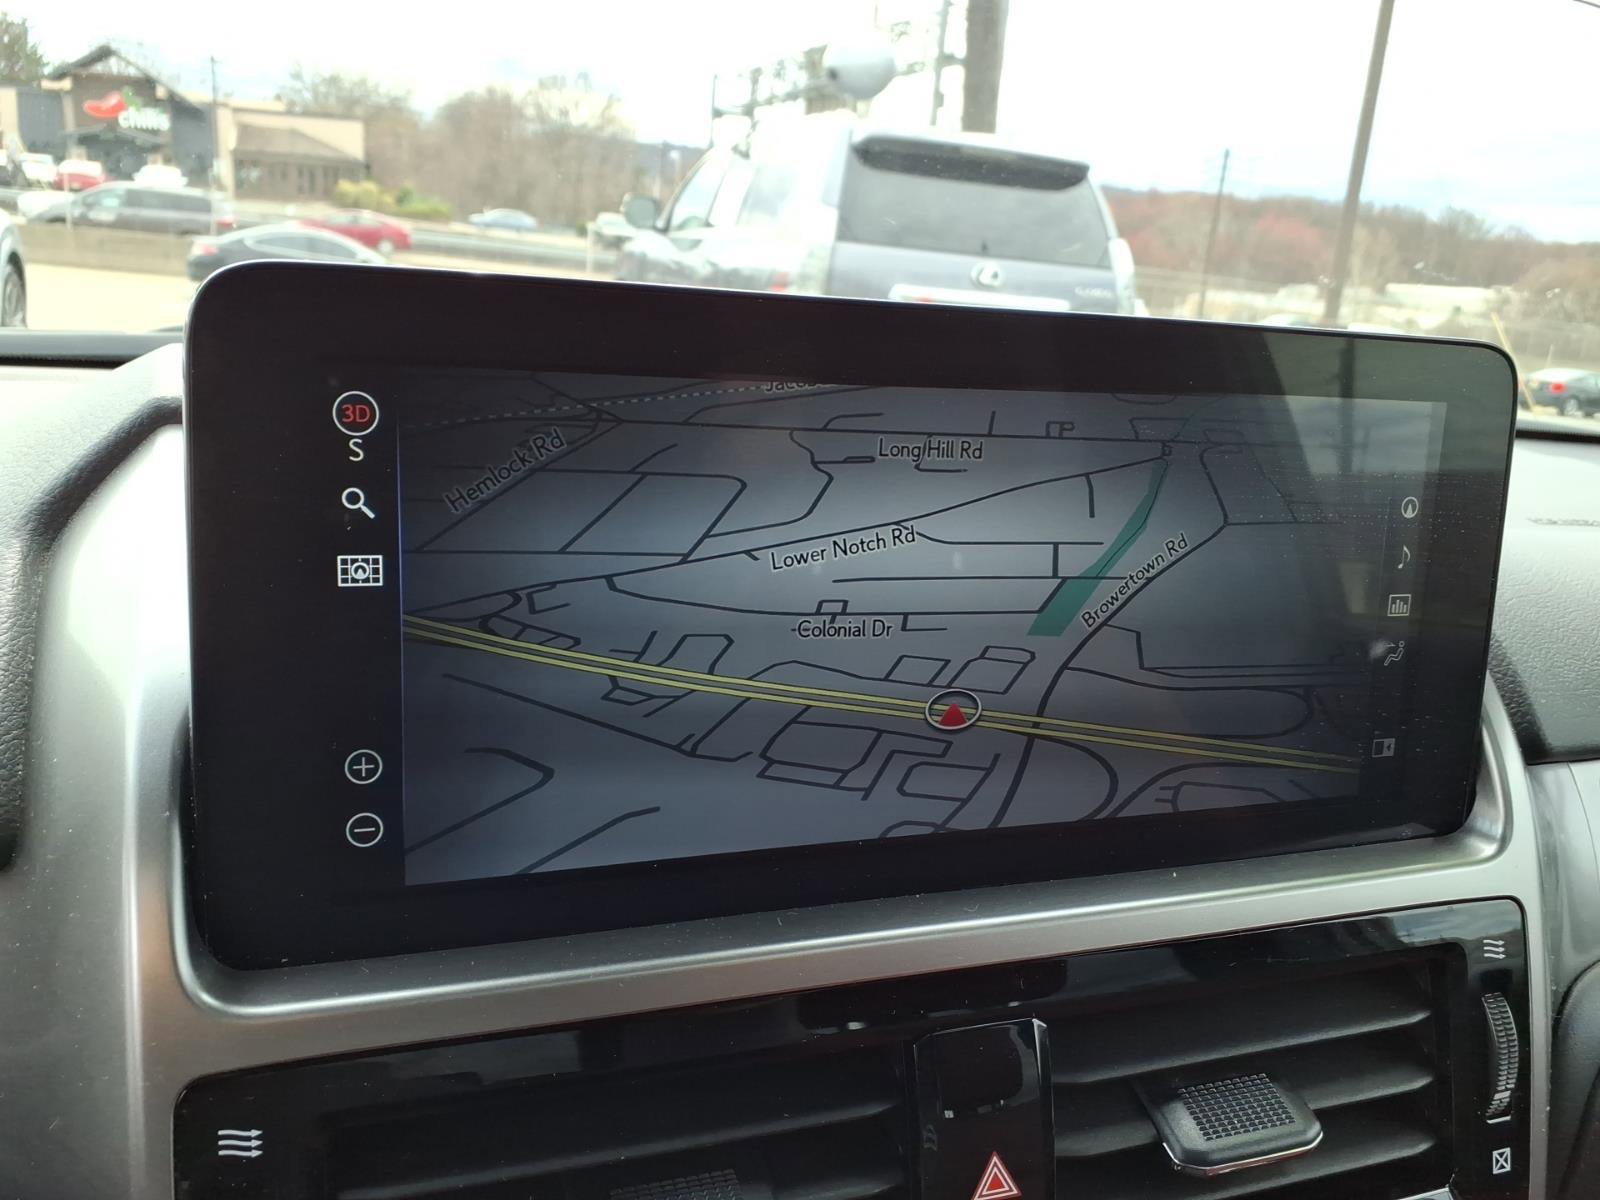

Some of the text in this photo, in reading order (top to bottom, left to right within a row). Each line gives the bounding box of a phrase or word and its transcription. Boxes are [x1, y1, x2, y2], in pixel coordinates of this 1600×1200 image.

[341, 404, 371, 423] 3D
[348, 438, 364, 462] S
[878, 437, 984, 463] Long Hill Rd
[443, 425, 567, 513] Hemlock Rd
[770, 524, 917, 571] Lower Notch Rd
[1080, 532, 1189, 629] Browertown Rd
[797, 618, 894, 638] Colonial Dr
